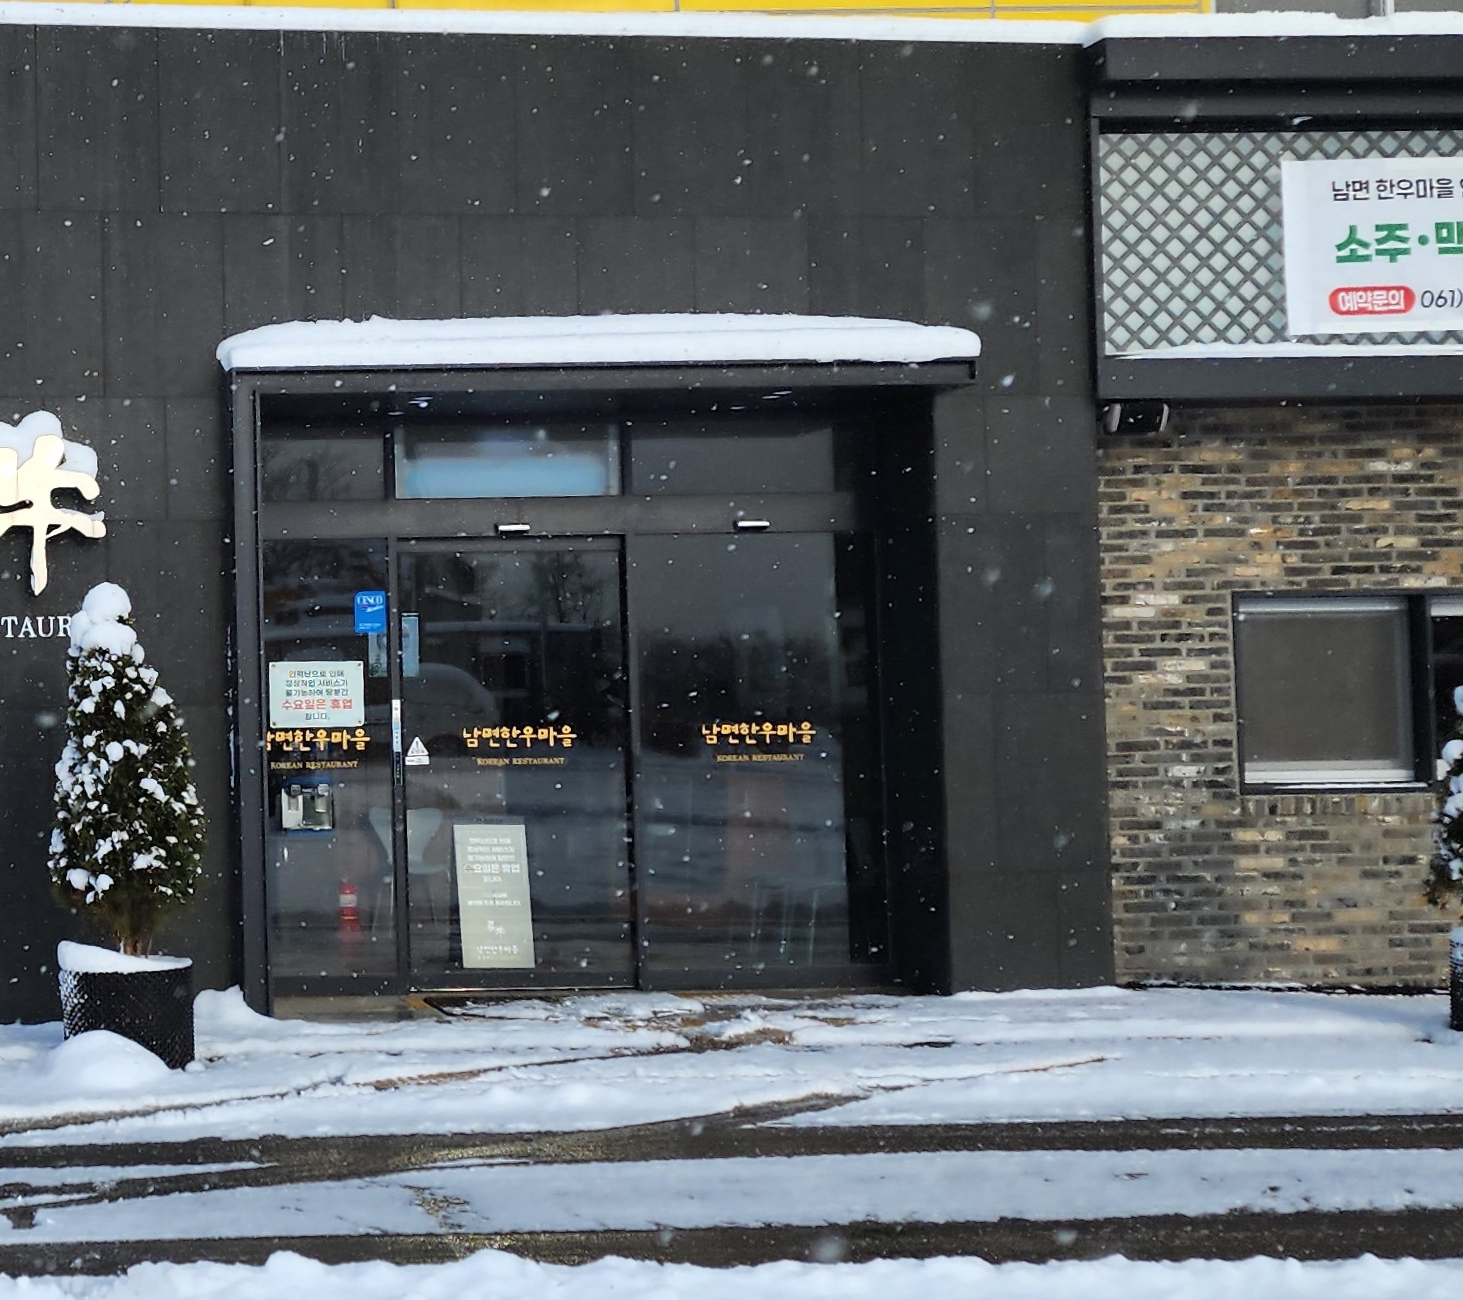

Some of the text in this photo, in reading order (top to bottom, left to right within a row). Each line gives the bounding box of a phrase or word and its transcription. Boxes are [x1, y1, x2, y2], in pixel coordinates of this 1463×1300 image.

[1331, 179, 1371, 202] 남면
[1375, 177, 1455, 201] 한우마을
[1337, 288, 1406, 312] 예약문의
[281, 698, 353, 711] 수요일은 휴업
[462, 724, 578, 748] 남면한우마을
[701, 721, 817, 745] 남면한우마을
[269, 760, 359, 770] KOREAN RESTAURANT
[476, 757, 566, 766] KOREAN RESTAURANT
[716, 753, 805, 763] KOREAN RESTAURANT
